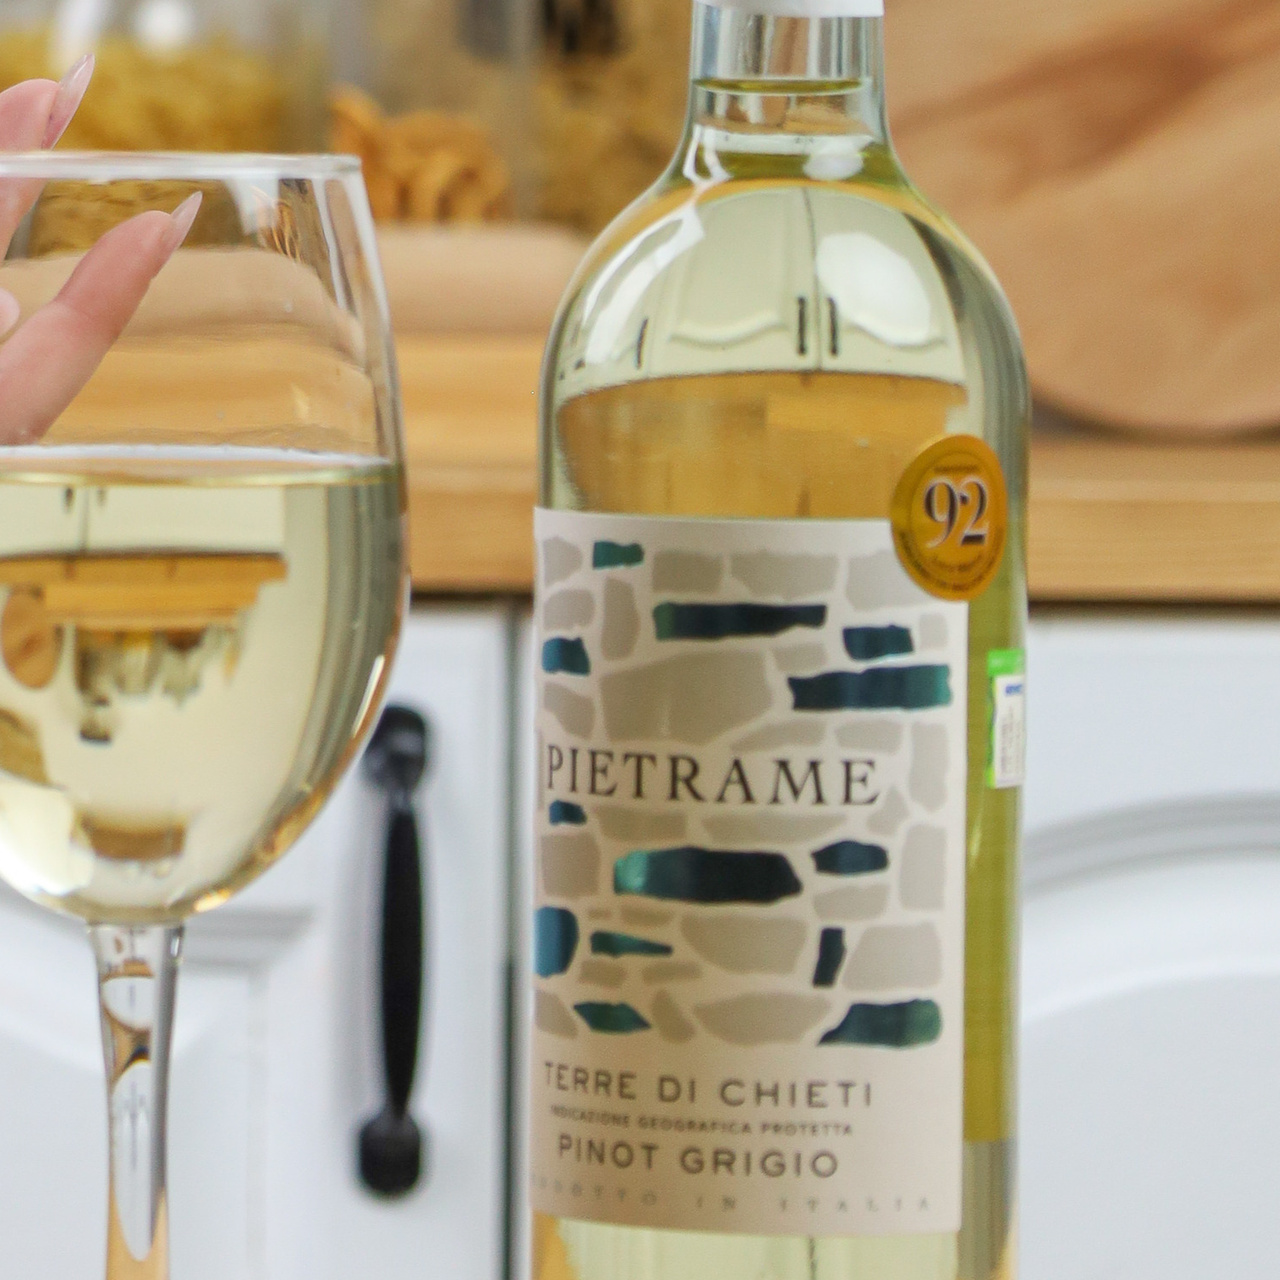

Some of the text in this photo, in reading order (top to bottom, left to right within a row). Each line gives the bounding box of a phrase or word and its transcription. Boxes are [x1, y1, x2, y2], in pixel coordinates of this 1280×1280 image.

[923, 476, 988, 549] 92
[547, 744, 880, 806] PIETRAME
[545, 1061, 871, 1108] TERRE DI CHIETI
[638, 1116, 751, 1134] GEOGRAFICA
[761, 1122, 852, 1136] PROTETTA
[558, 1133, 838, 1178] PINOT GRIGIO
